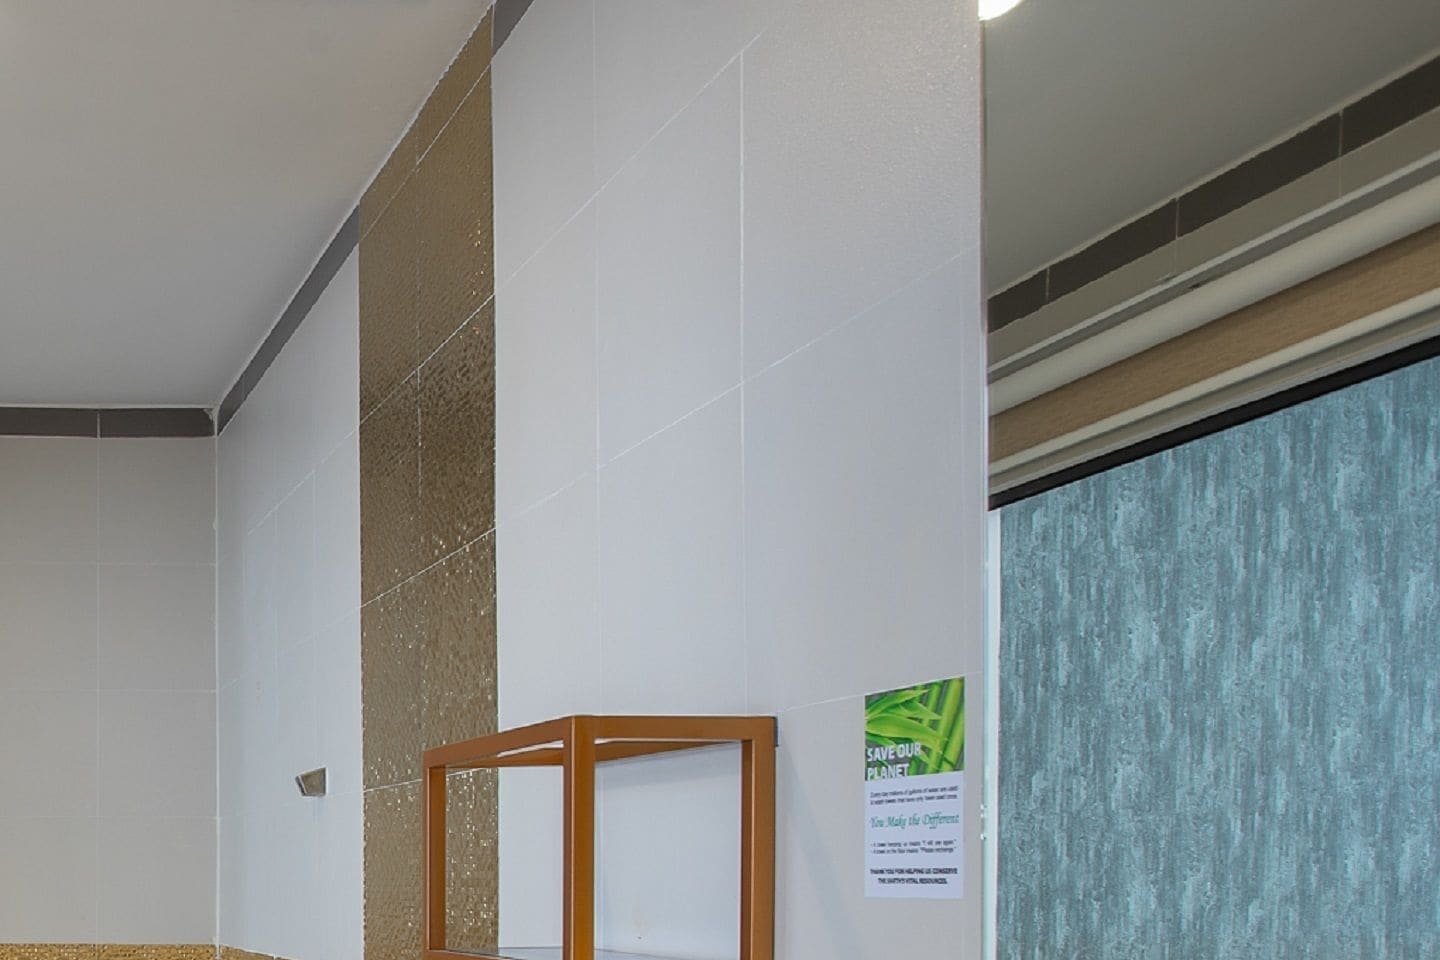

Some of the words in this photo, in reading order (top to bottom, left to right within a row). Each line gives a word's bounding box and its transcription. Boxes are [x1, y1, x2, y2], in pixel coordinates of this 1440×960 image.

[867, 747, 895, 762] SAVE
[897, 742, 921, 758] OUR
[867, 763, 909, 781] PLANET
